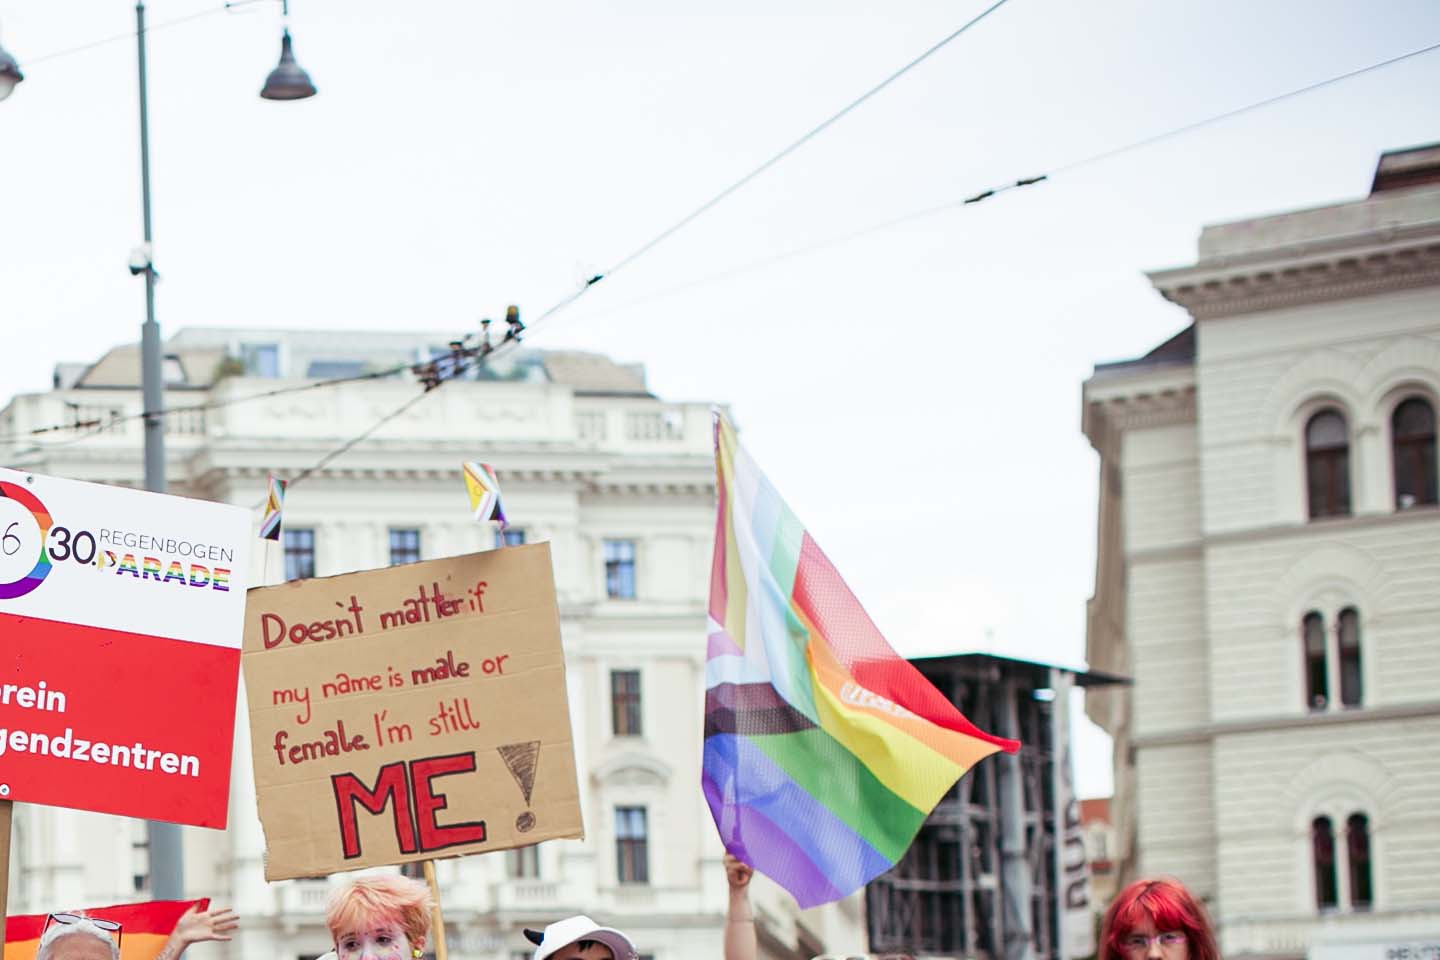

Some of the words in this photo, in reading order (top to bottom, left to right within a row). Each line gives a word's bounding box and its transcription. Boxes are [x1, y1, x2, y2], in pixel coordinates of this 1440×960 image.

[99, 528, 234, 563] REGENBOGEN
[97, 549, 232, 592] PARADE
[380, 582, 464, 631] matter
[468, 582, 488, 613] if
[272, 686, 311, 724] my
[322, 673, 382, 698] name
[387, 667, 404, 687] is
[412, 651, 470, 685] male
[482, 654, 508, 675] or
[374, 710, 412, 747] I'm
[429, 698, 480, 736] still
